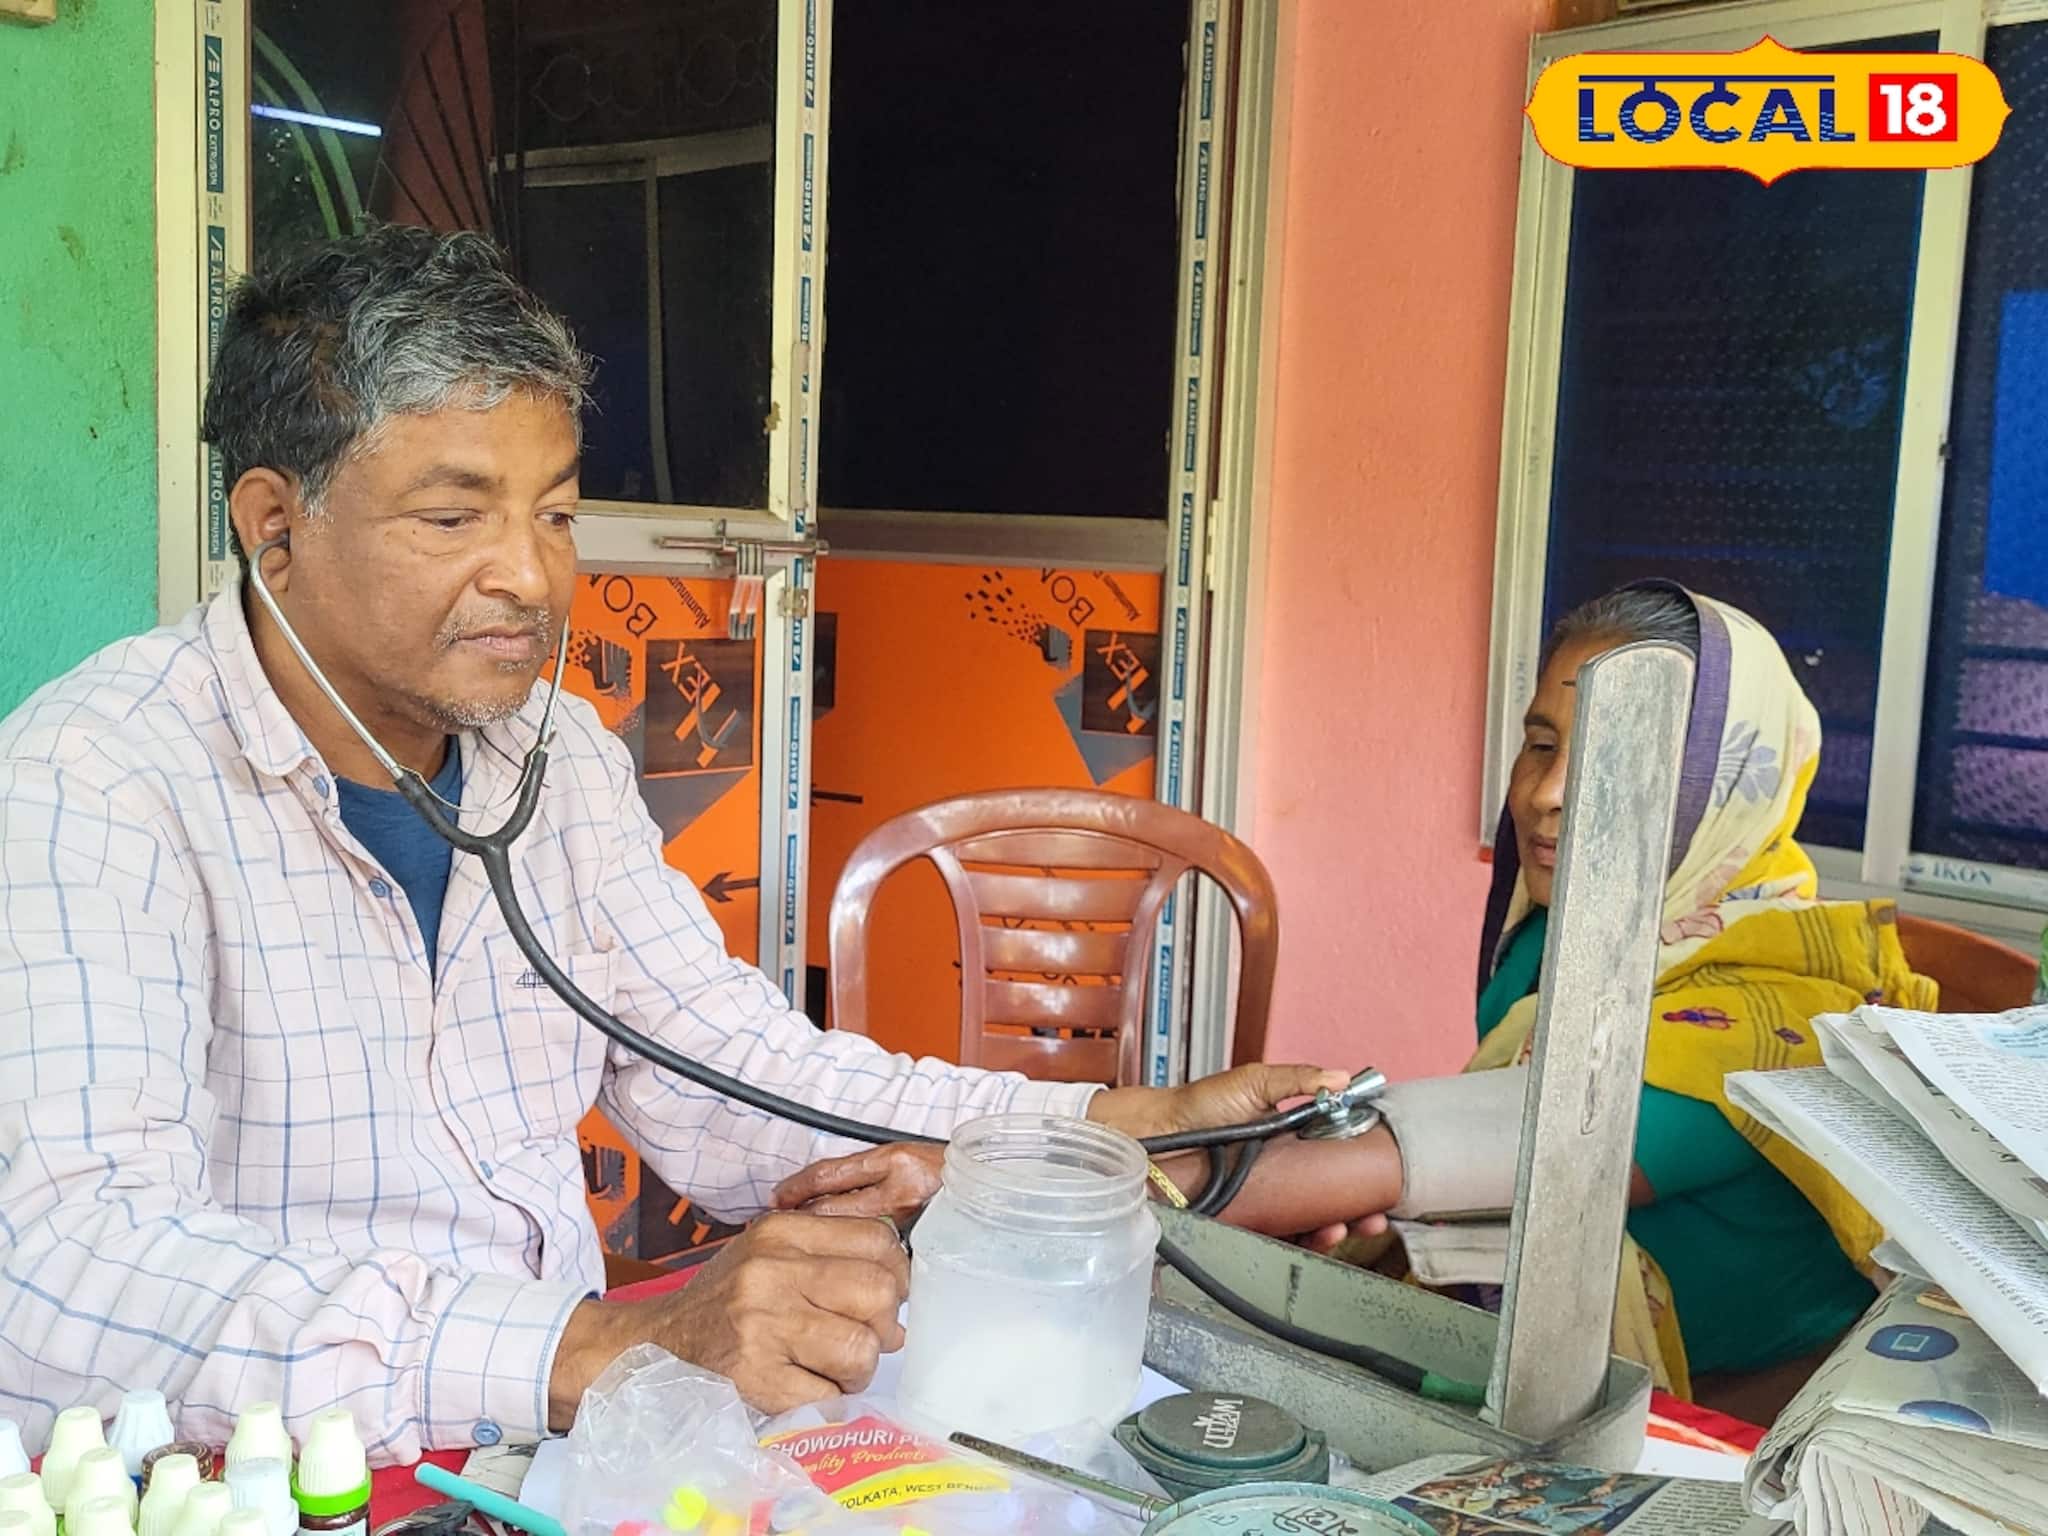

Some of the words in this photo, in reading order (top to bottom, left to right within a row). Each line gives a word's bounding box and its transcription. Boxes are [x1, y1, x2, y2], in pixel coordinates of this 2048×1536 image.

[209, 77, 221, 131] ALPRO
[209, 134, 218, 185] EXTRUSION
[211, 266, 222, 318] ALPRO
[211, 448, 223, 501] ALPRO
[802, 1453, 847, 1476] uality
